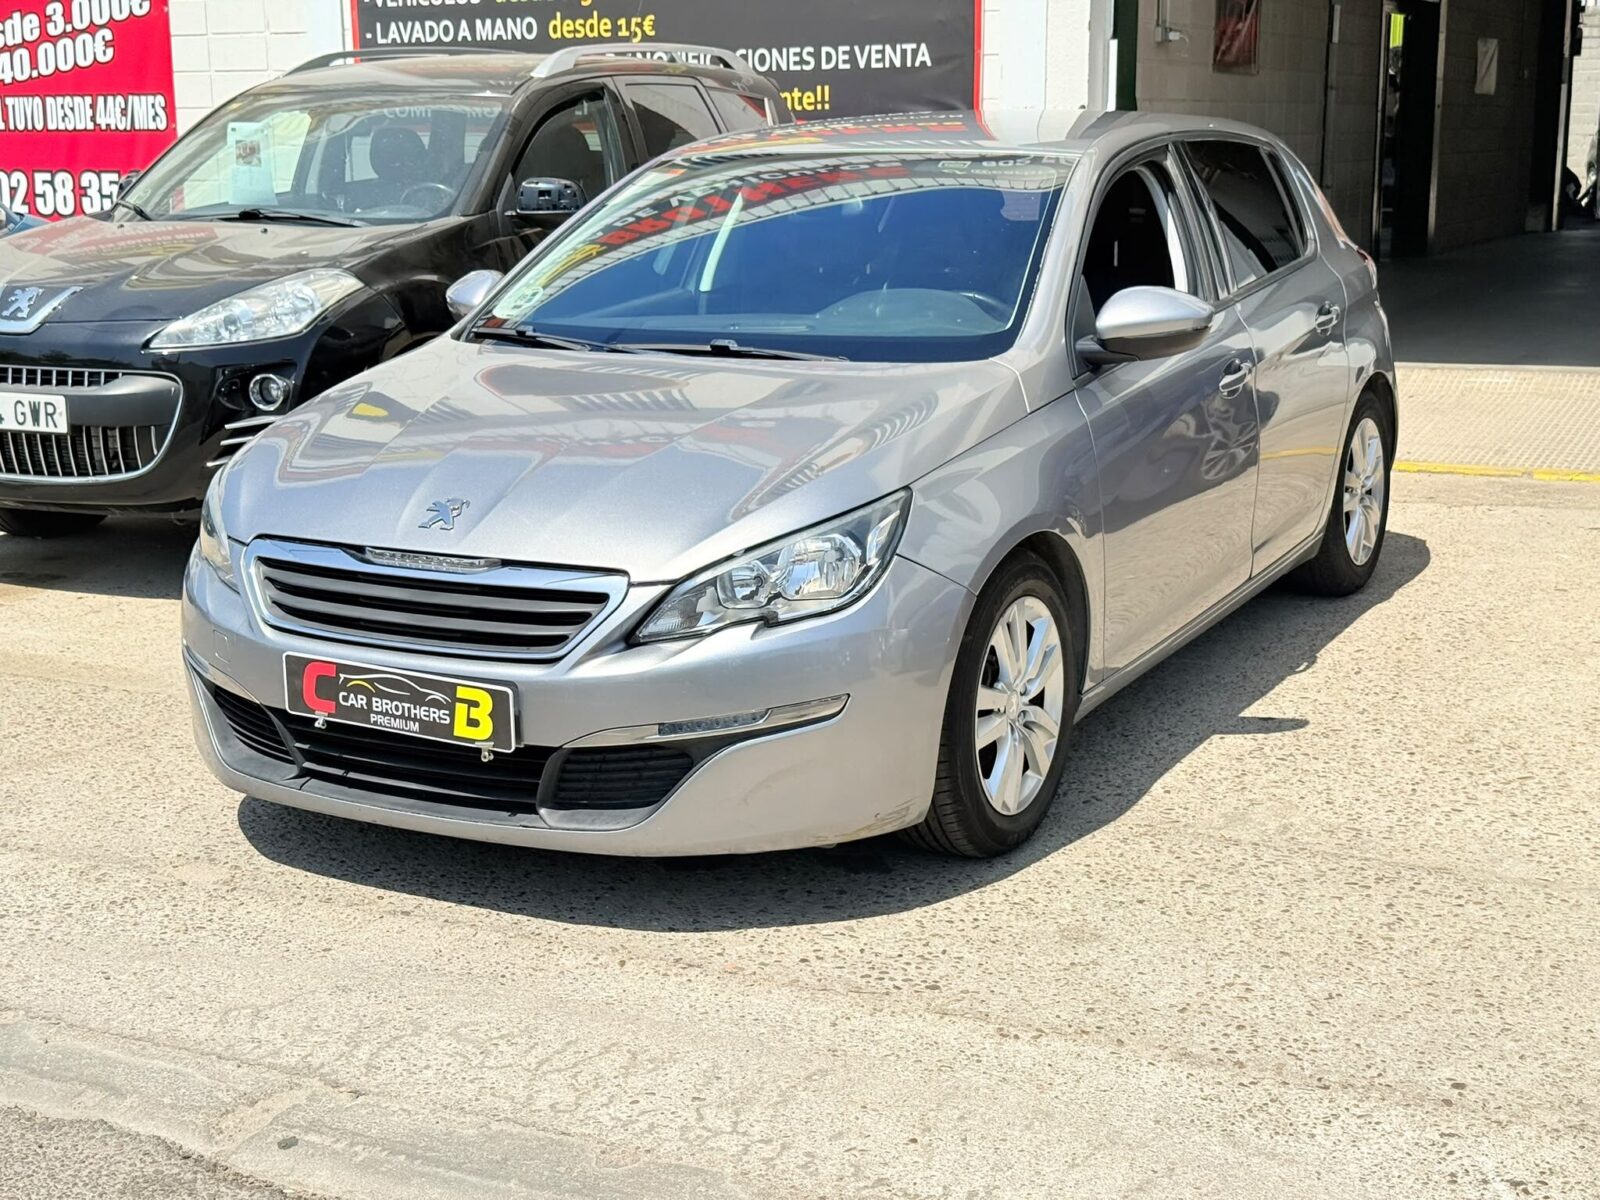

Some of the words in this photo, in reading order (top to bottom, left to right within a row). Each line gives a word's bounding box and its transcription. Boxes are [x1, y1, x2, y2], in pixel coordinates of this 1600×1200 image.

[376, 20, 454, 44] LAVADO
[457, 19, 472, 41] A
[475, 16, 537, 41] MANO
[549, 11, 612, 39] desde
[617, 15, 655, 43] 15€
[821, 46, 850, 70] DE
[854, 43, 931, 69] VENTA
[6, 95, 44, 130] TUYO
[46, 95, 94, 130] DESDE
[96, 94, 167, 131] 44€/MES
[34, 171, 74, 216] 58
[80, 171, 119, 214] 35
[14, 400, 57, 428] GWR
[302, 661, 336, 713] C
[339, 691, 367, 710] CAR
[372, 696, 450, 725] BROTHERS
[370, 713, 420, 733] PREMIUM
